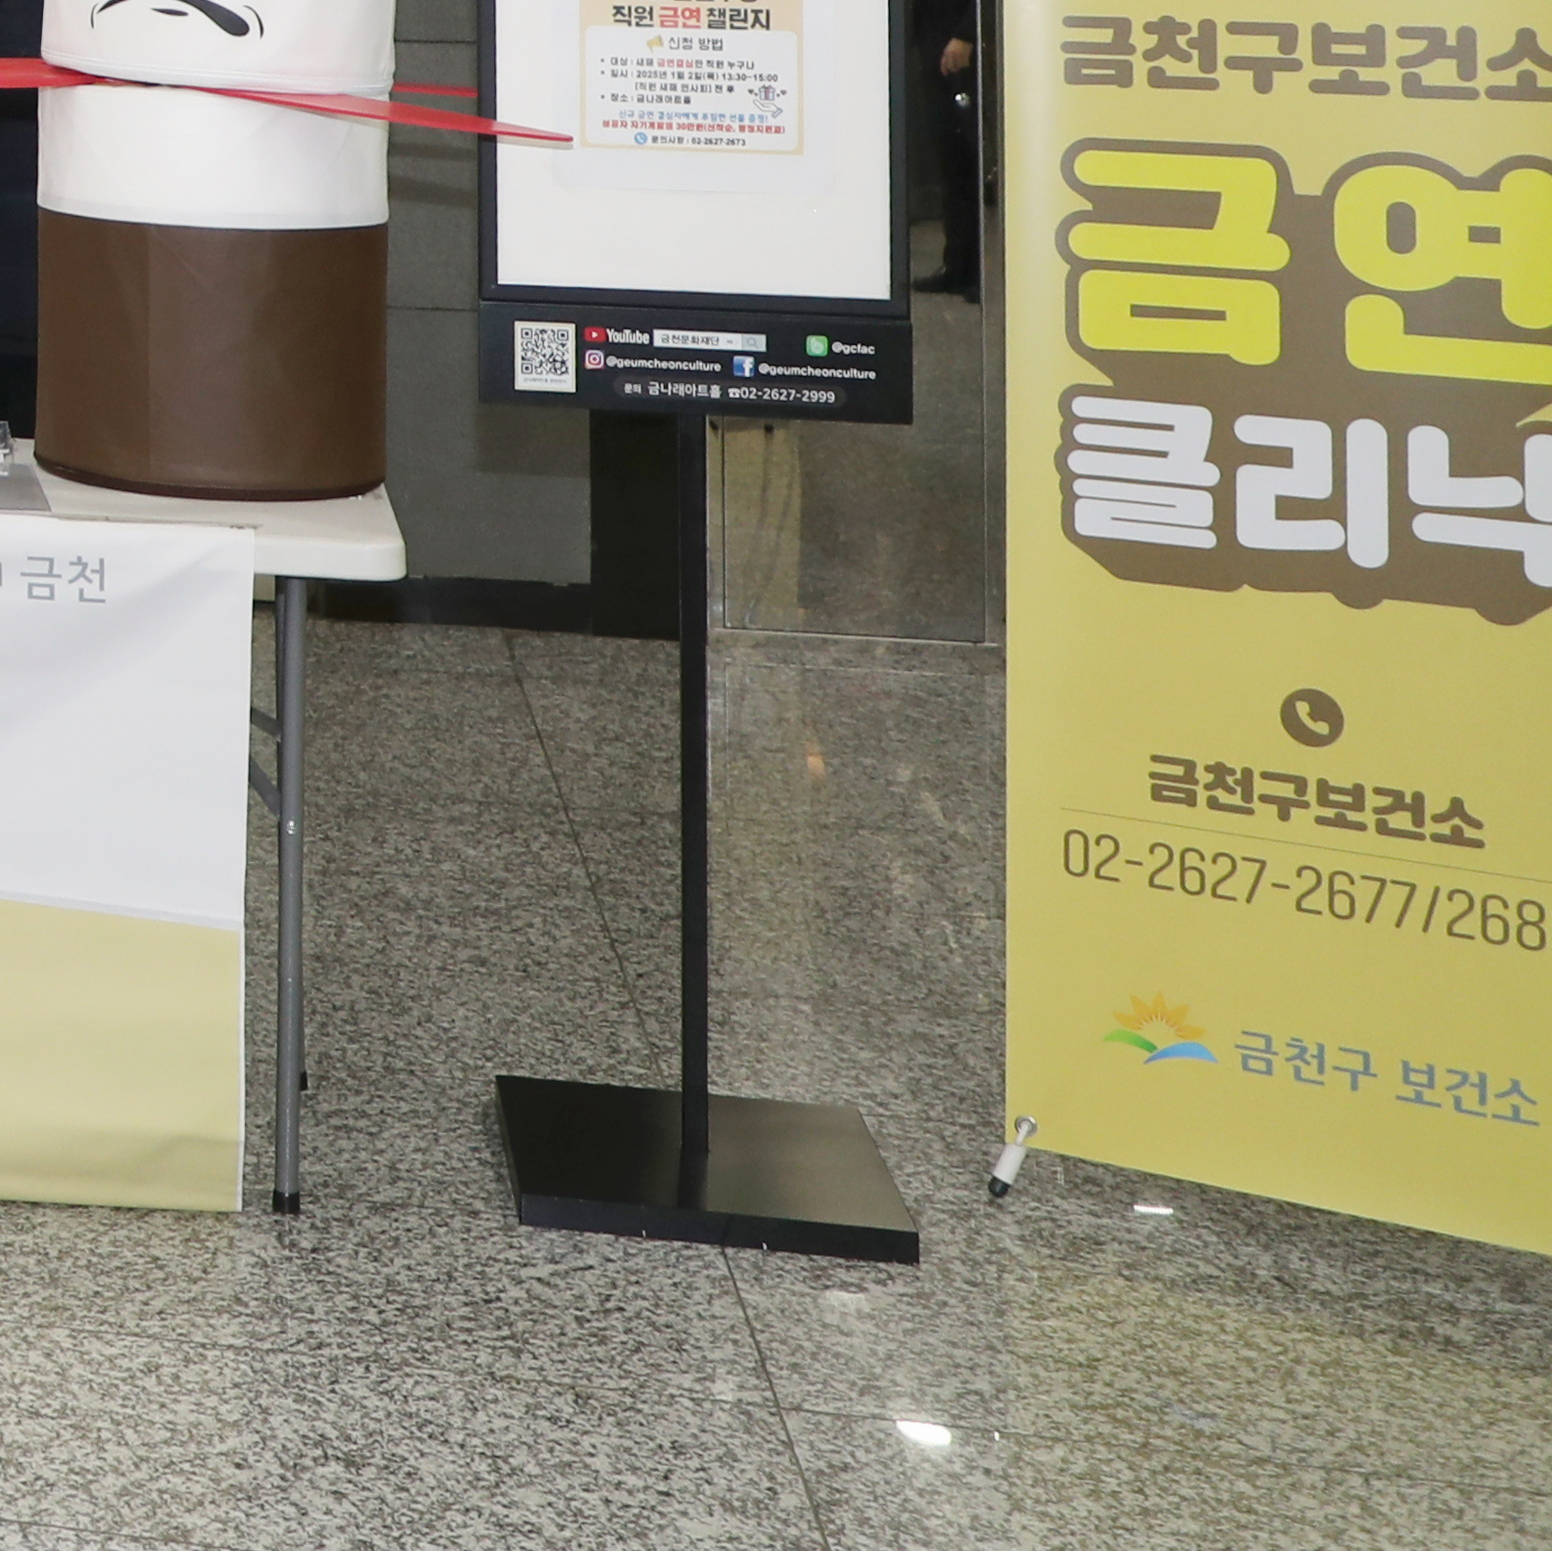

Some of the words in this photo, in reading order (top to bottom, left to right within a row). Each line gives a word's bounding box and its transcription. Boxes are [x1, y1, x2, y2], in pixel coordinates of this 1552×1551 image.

[612, 5, 654, 28] 직원
[658, 6, 701, 29] 금연
[706, 8, 770, 31] 챌린지
[668, 37, 694, 50] 신청
[698, 38, 724, 51] 방법
[1060, 14, 1552, 102] 금천구보건소
[1066, 148, 1552, 386] 금연
[606, 328, 650, 345] YouTube
[660, 334, 720, 347] 금천문화재단
[832, 341, 875, 356] @gcfac
[606, 356, 722, 373] @geumcheonculture
[758, 362, 877, 381] @geumcheonculture
[624, 383, 642, 394] 문의
[647, 381, 722, 398] 금나래아트홀
[740, 386, 836, 404] 02-2627-2999
[20, 555, 106, 604] 금천
[1148, 753, 1486, 849] 금천구보건소
[1234, 1029, 1378, 1091] 금천구
[1396, 1058, 1541, 1128] 보건소
